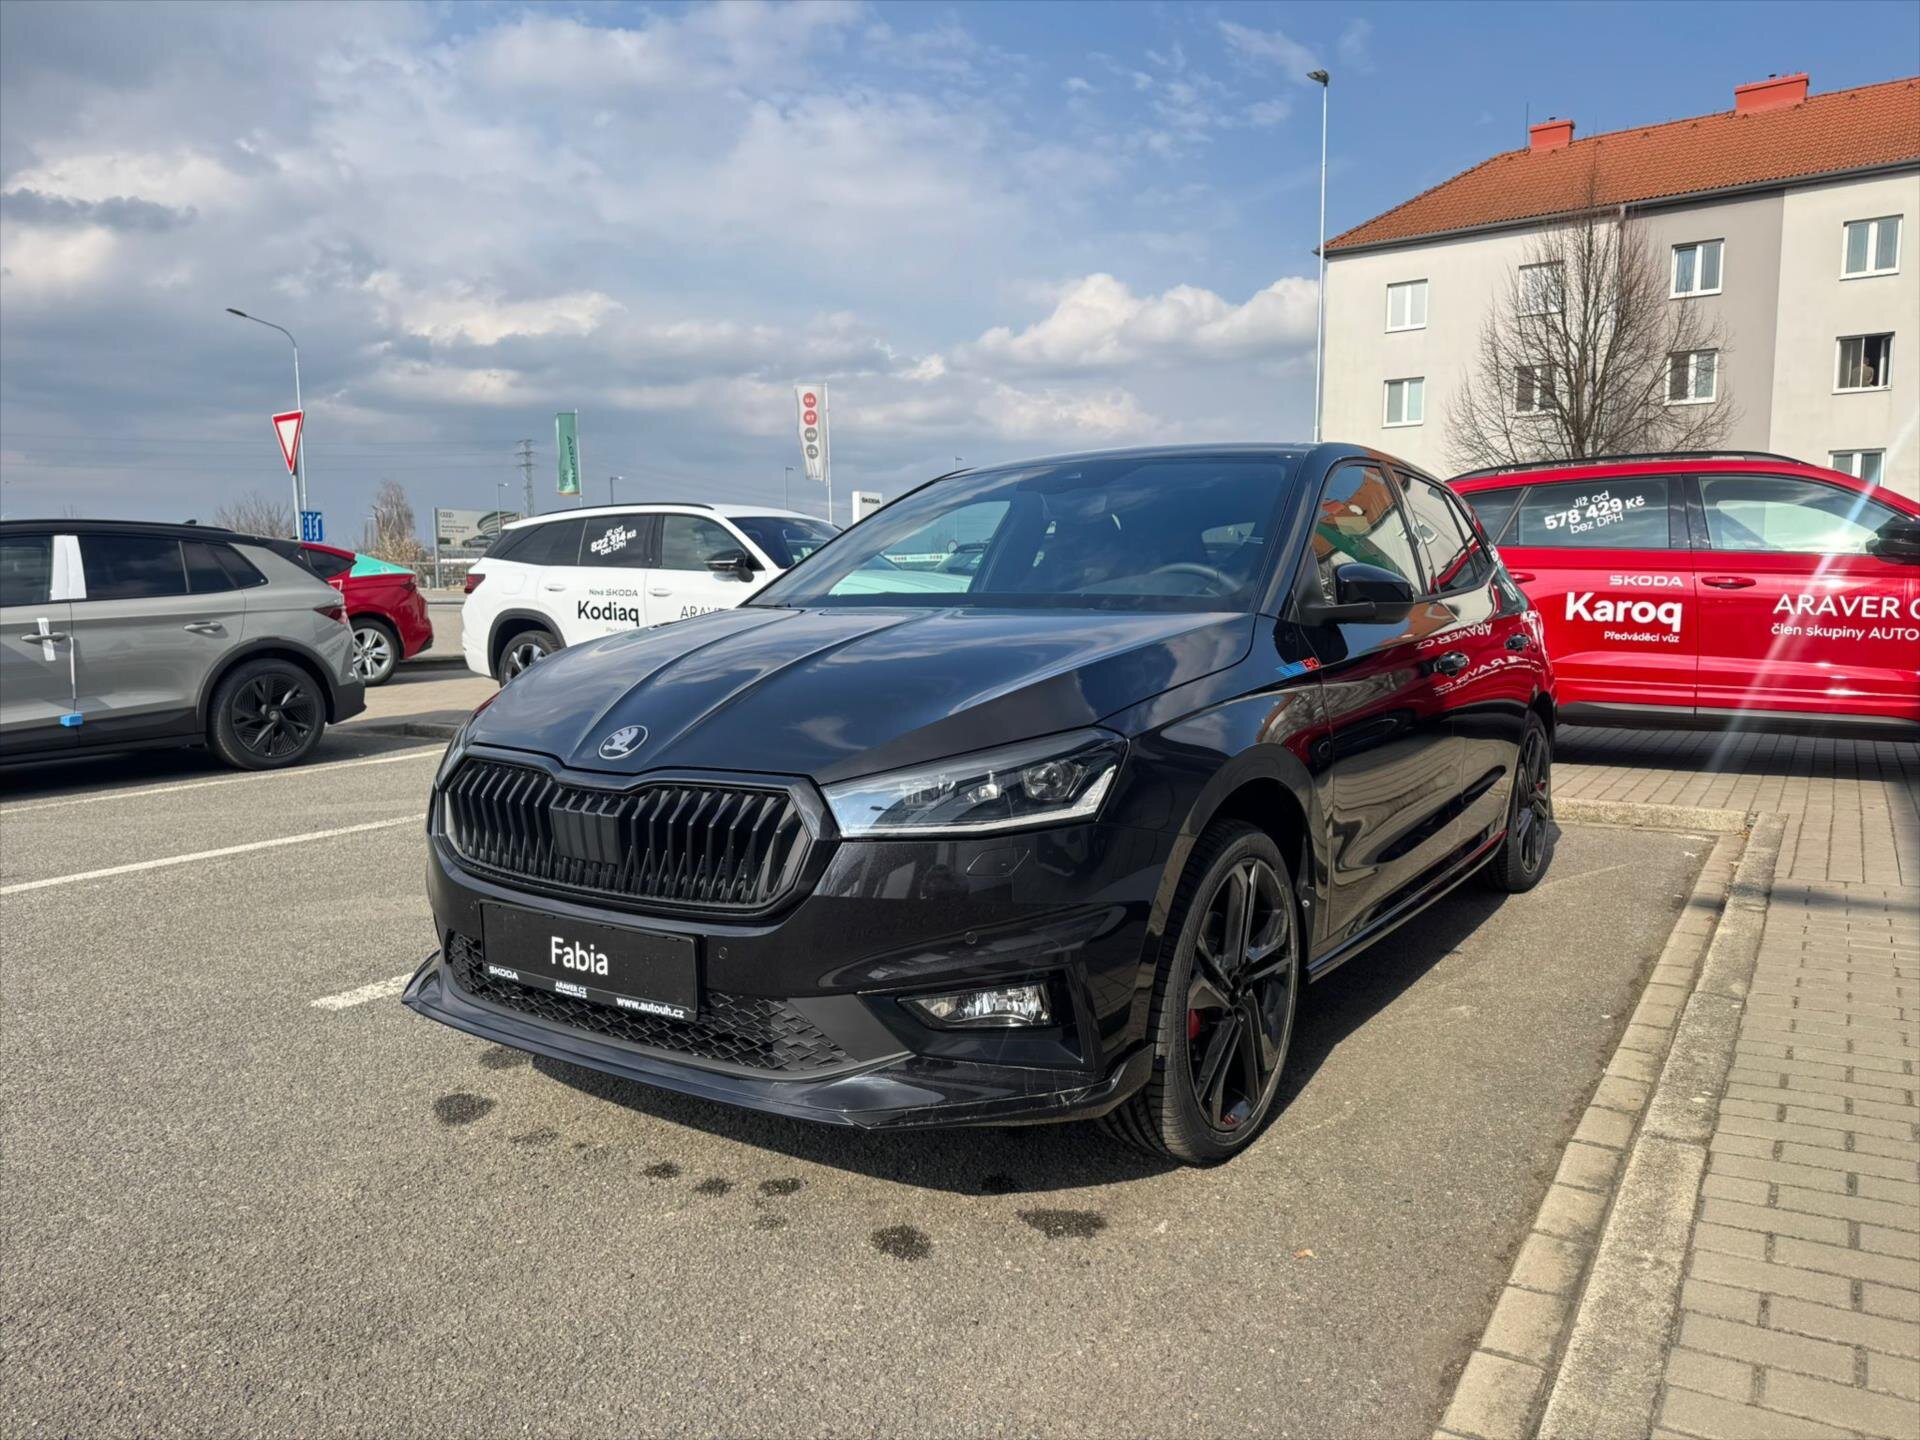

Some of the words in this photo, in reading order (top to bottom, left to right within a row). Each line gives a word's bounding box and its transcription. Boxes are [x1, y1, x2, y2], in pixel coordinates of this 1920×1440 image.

[1591, 490, 1610, 503] od
[1544, 509, 1581, 530] 578
[1585, 498, 1623, 518] 429
[1625, 495, 1645, 509] Kč
[1569, 521, 1594, 534] bez
[1596, 512, 1624, 527] DPH
[577, 600, 640, 627] Kodiaq
[1565, 592, 1683, 633] Karoq
[1773, 593, 1900, 619] ARAVER
[1604, 631, 1660, 642] Předváděcí
[1771, 622, 1802, 635] člen
[1806, 625, 1865, 641] skupiny
[1868, 627, 1919, 641] AUTO
[551, 936, 608, 976] Fabia
[616, 997, 685, 1019] www.autouh.cz
